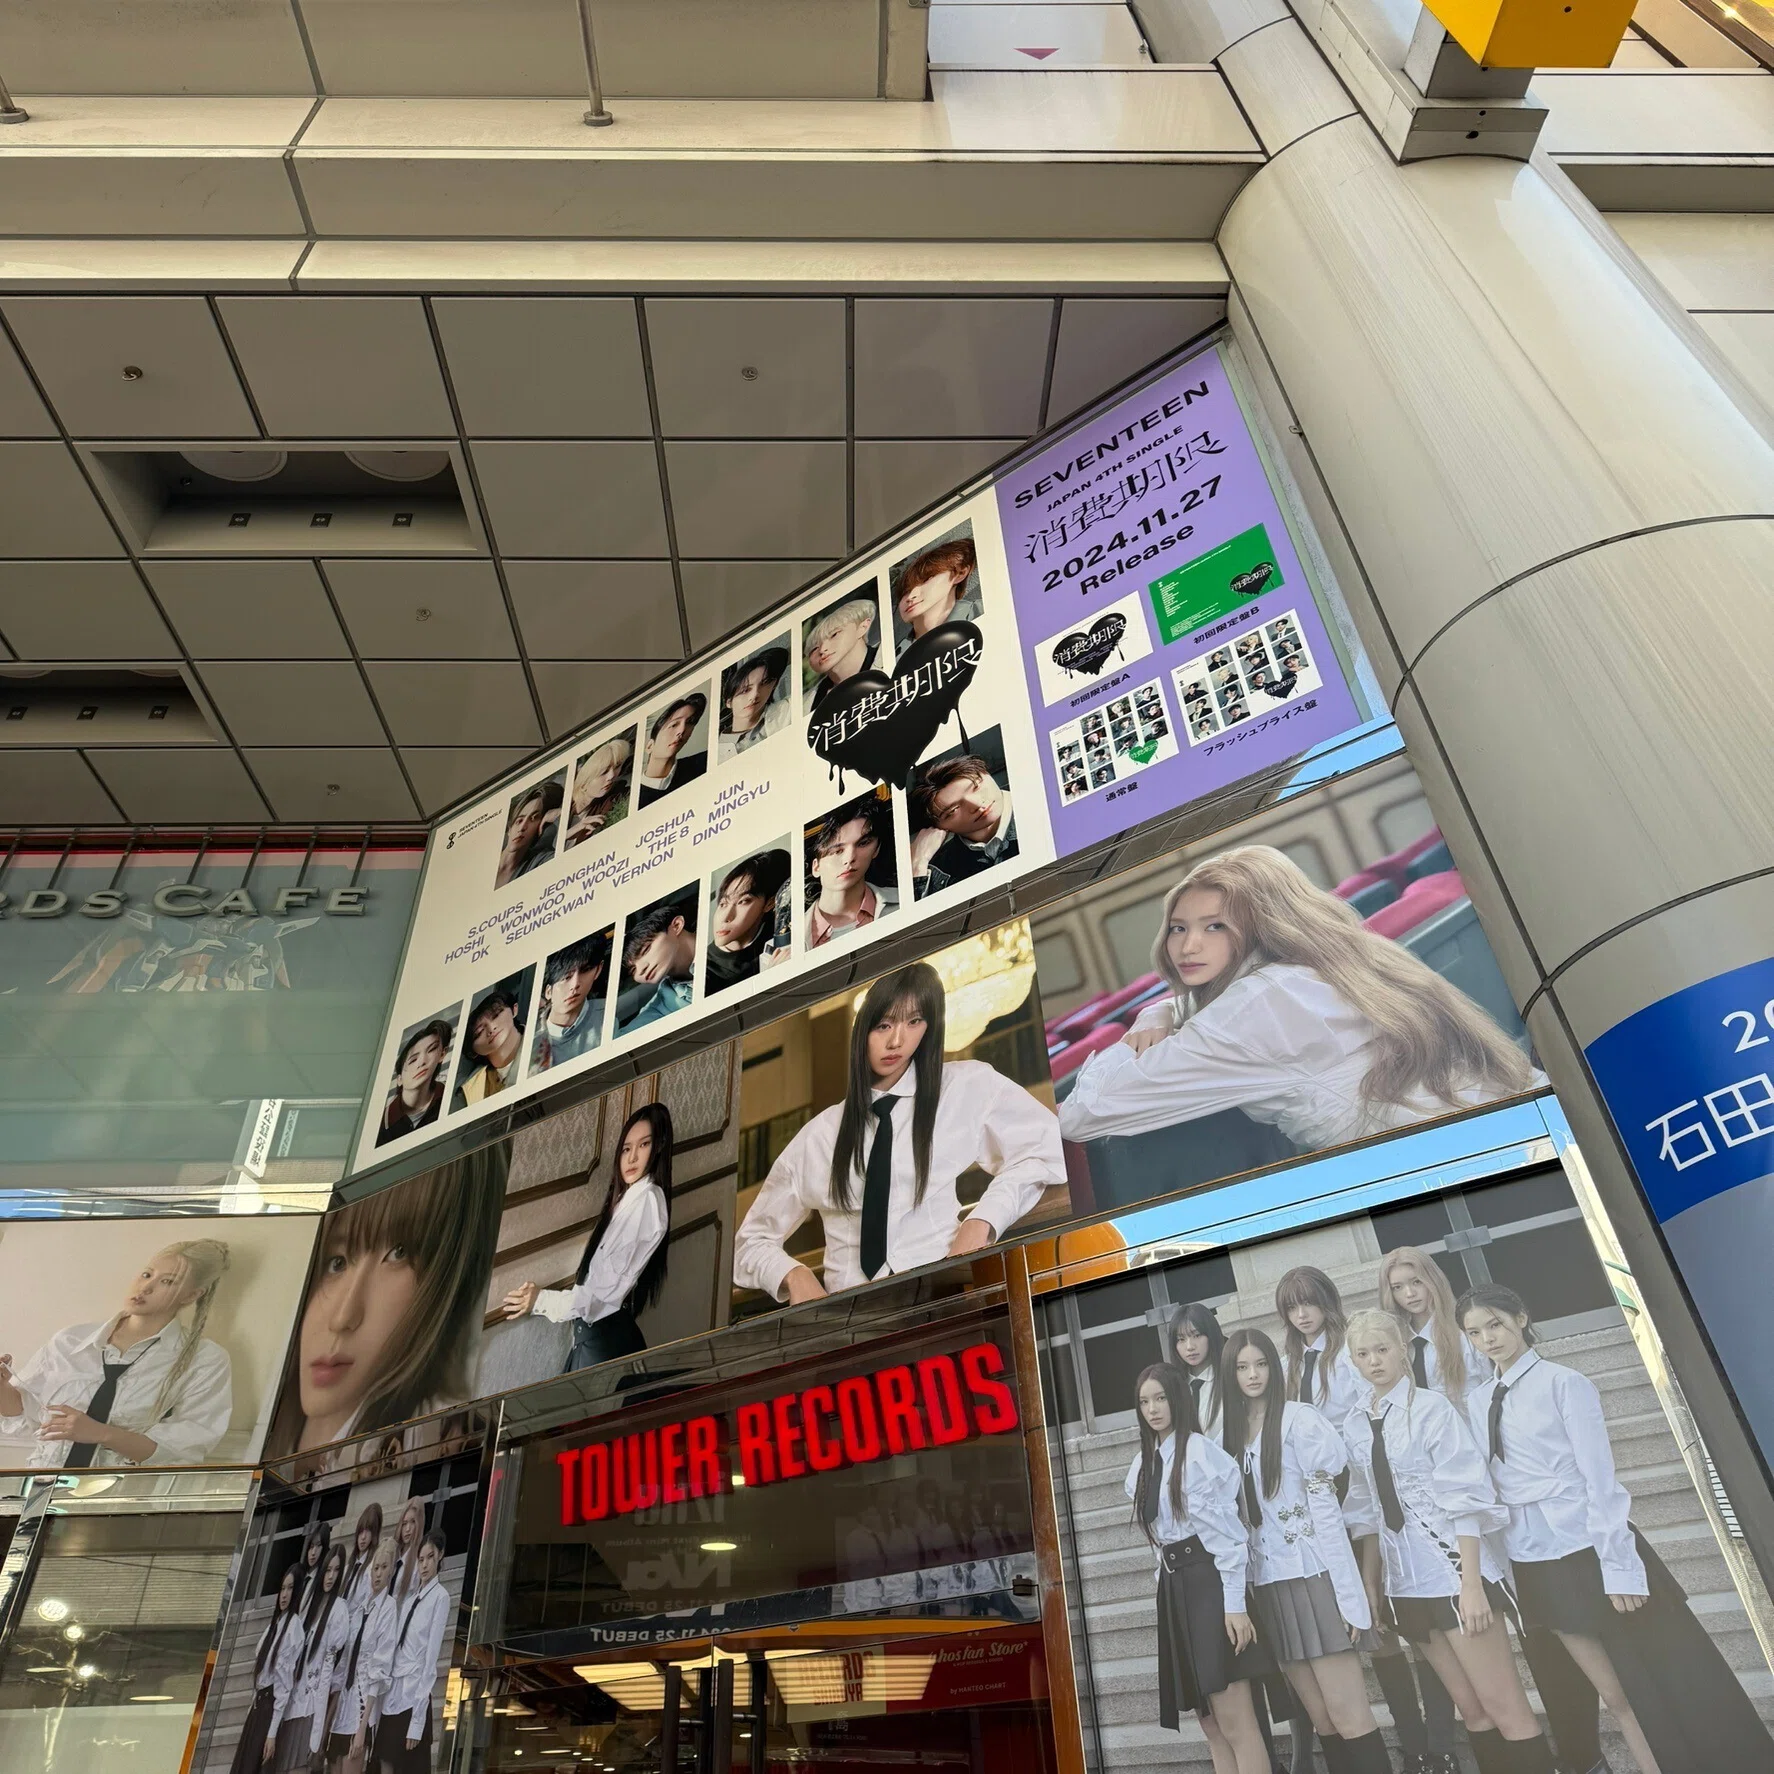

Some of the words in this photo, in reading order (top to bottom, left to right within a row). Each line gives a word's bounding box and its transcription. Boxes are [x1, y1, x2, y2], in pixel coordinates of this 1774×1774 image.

[1014, 380, 1210, 509] SEVENTEEN
[1024, 431, 1229, 564] 消費期限
[1046, 481, 1092, 512] JAPAN
[1095, 462, 1123, 482] 4TH
[1126, 425, 1184, 464] SINGLE
[1041, 474, 1222, 593] 2024.11.27
[1080, 525, 1194, 596] Release
[808, 638, 983, 752] 消費期限
[0, 889, 129, 919] DS
[153, 883, 370, 918] CAFE
[444, 935, 485, 964] HOSHI
[500, 892, 566, 934] WONWOO
[581, 857, 630, 890] WOOZI
[648, 834, 677, 855] THE
[680, 826, 690, 843] 8
[707, 781, 772, 824] MINGYU
[468, 901, 525, 939] S.COUPS
[539, 851, 616, 900] JEONGHAN
[635, 809, 696, 848] JOSHUA
[713, 780, 745, 805] JUN
[471, 945, 490, 963] DK
[505, 890, 595, 945] SEUNGKWAN
[611, 848, 674, 889] VERNON
[692, 817, 733, 846] DINO
[1645, 1072, 1774, 1172] 石田
[556, 1415, 734, 1526] TOWER
[737, 1342, 1019, 1487] RECORDS
